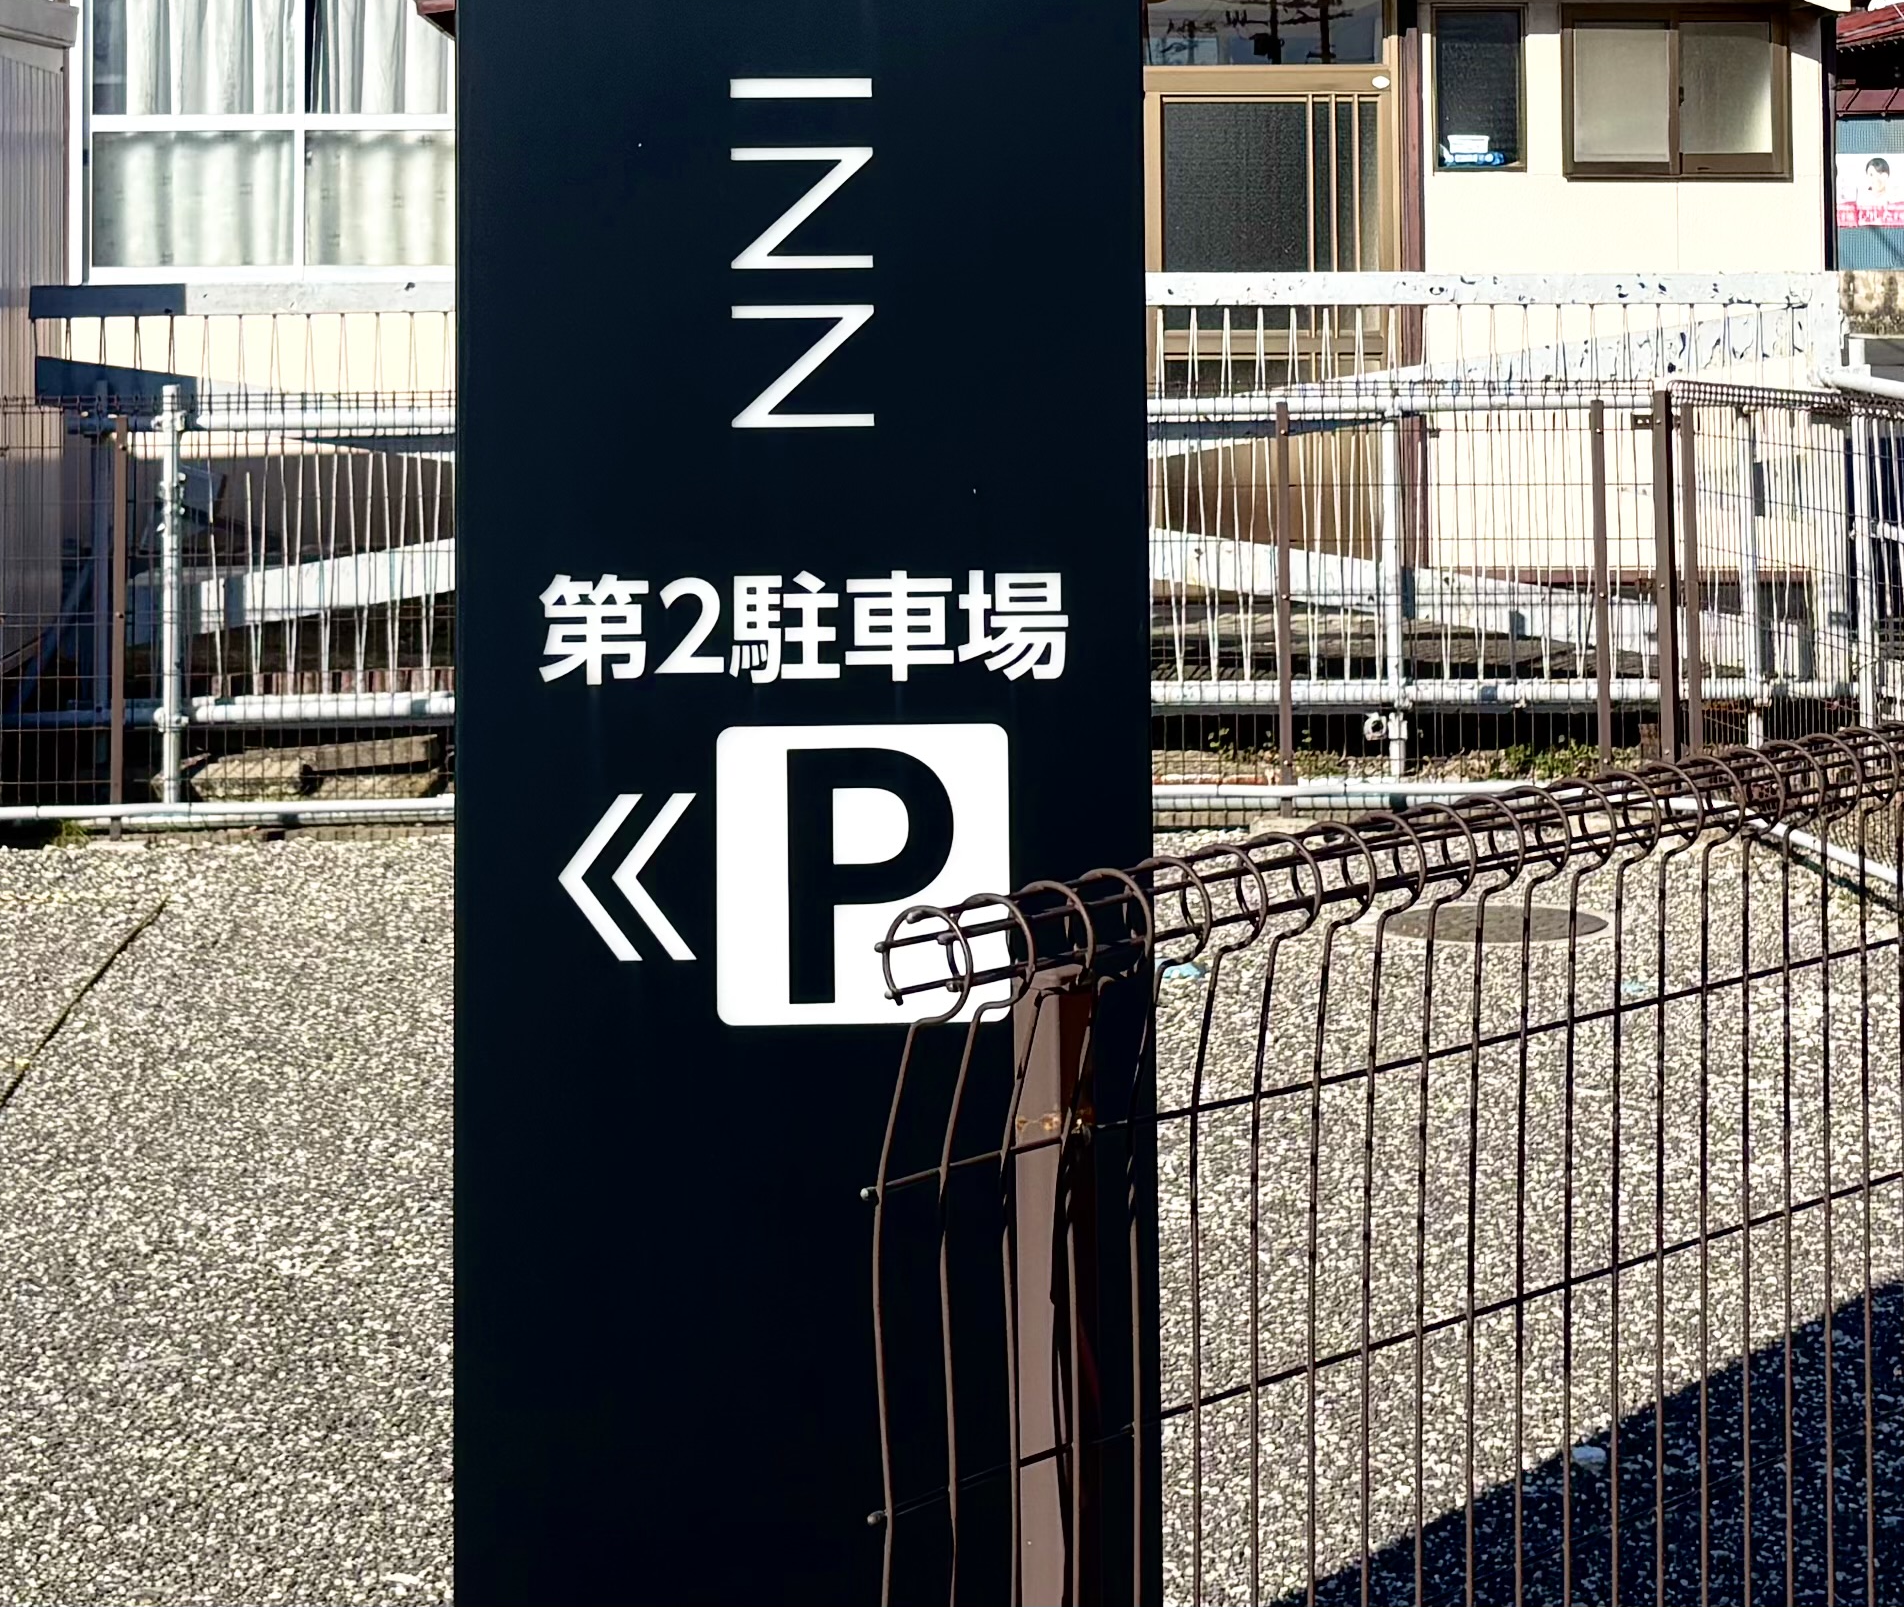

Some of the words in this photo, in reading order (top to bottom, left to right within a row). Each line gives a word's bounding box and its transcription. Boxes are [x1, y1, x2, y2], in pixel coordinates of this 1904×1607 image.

[729, 76, 876, 428] INN
[537, 569, 1070, 686] 第2駐車場
[786, 746, 955, 1005] P
